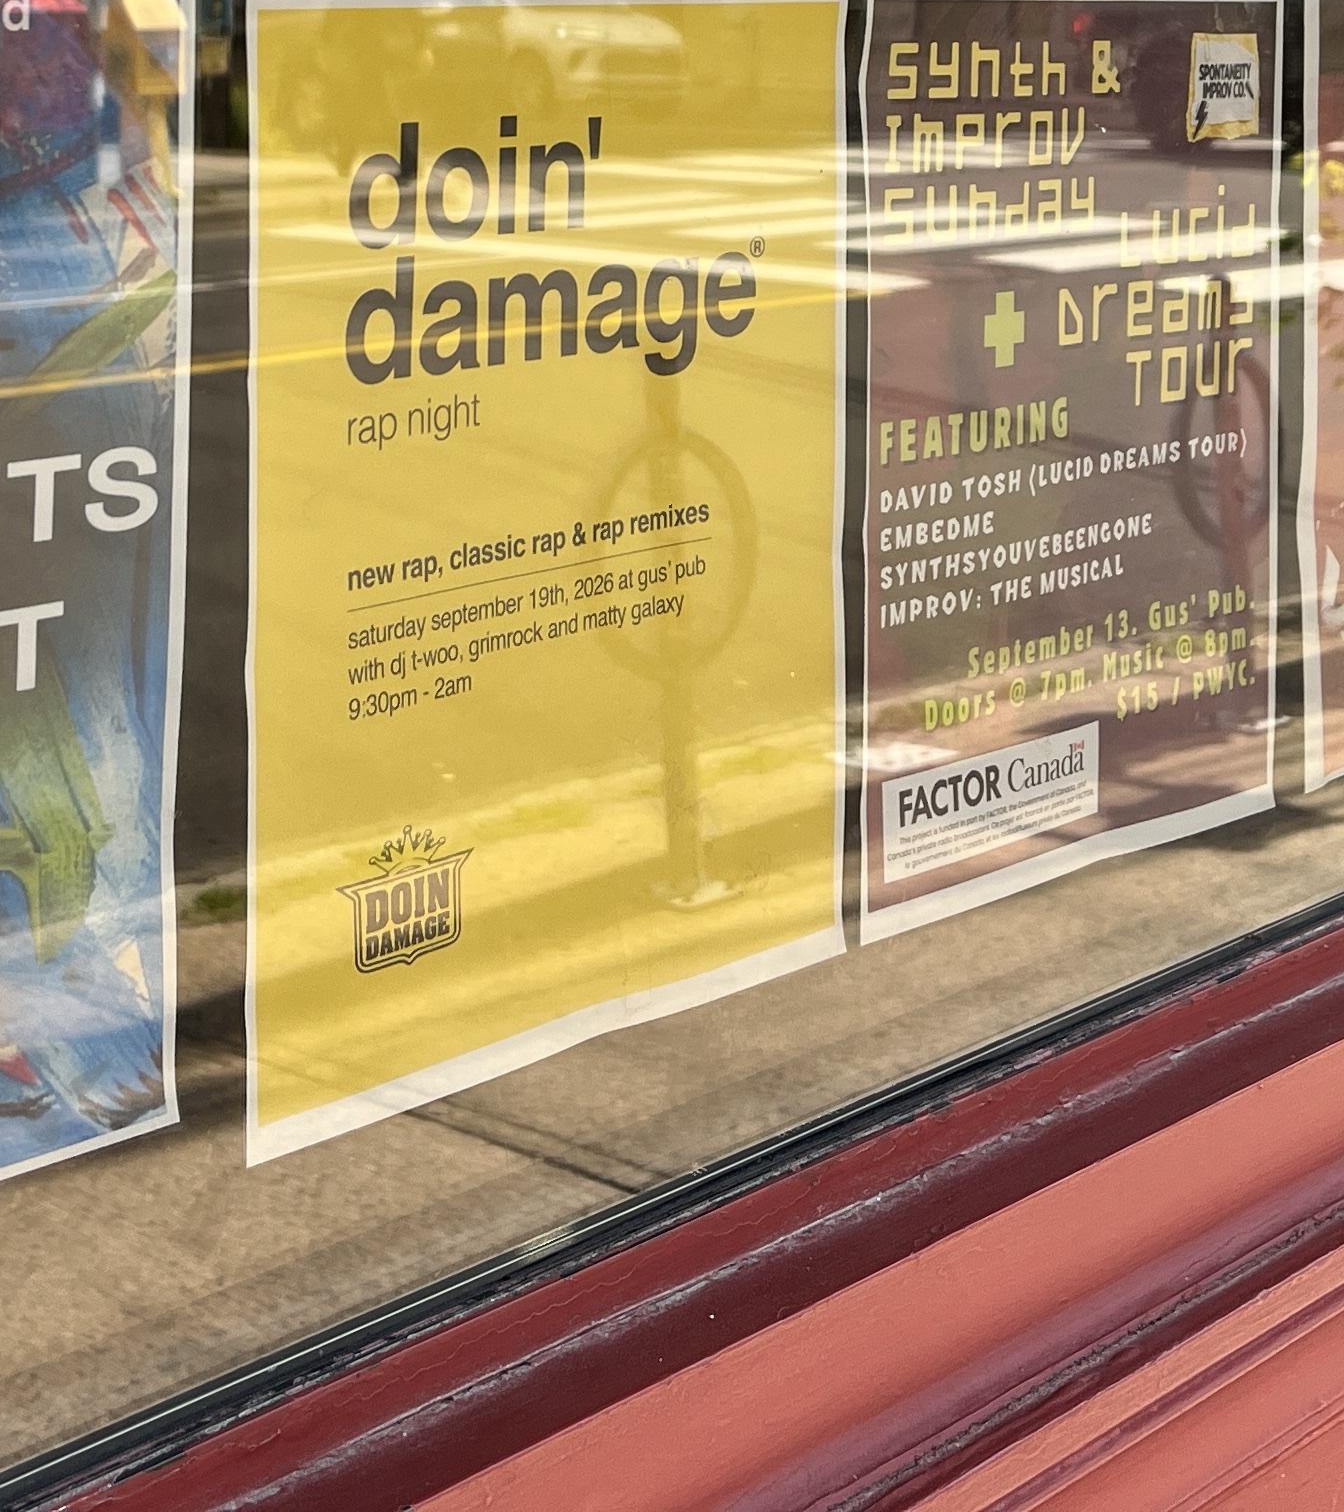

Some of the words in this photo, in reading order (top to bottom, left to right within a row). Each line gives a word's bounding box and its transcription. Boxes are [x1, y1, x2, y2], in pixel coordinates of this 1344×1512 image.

[1092, 40, 1120, 94] &
[1199, 62, 1252, 80] SPONTANEITY
[1202, 81, 1232, 99] IMPROV
[349, 116, 602, 249] doin'
[347, 413, 397, 450] rap
[408, 394, 480, 442] night
[879, 396, 1069, 465] FEATURING
[880, 481, 953, 513] DAVID
[962, 469, 1021, 499] TOSH
[1029, 455, 1092, 496] (LUCID
[1100, 441, 1181, 474] DREAMS
[1188, 428, 1247, 459] TOUR)
[348, 563, 394, 591] new
[402, 554, 443, 582] rap,
[450, 533, 525, 570] classic
[532, 529, 565, 555] rap
[572, 522, 586, 546] &
[593, 519, 624, 544] rap
[631, 503, 709, 535] remixes
[880, 511, 994, 552] EMBEDME
[880, 513, 1153, 590] SYNTHSYOUVEBEENGONE
[348, 615, 426, 649] saturday
[431, 596, 523, 633] september
[529, 584, 569, 610] 19th,
[574, 573, 614, 601] 2026
[618, 567, 633, 590] at
[675, 555, 706, 584] pub
[880, 588, 981, 628] IMPROV:
[991, 576, 1032, 605] THE
[1040, 555, 1124, 595] MUSICAL
[348, 658, 384, 685] with
[391, 650, 406, 678] dj
[411, 642, 463, 670] t-woo,
[468, 621, 543, 663] grimrock
[548, 613, 578, 640] and
[583, 603, 626, 632] matty
[632, 594, 684, 626] galaxy
[967, 623, 1093, 678] September
[349, 691, 417, 721] 9:30pm
[435, 674, 472, 700] 2am
[924, 688, 996, 731] Doors
[1009, 676, 1027, 707] @
[1103, 644, 1164, 682] Music
[1176, 633, 1193, 664] @
[1117, 682, 1158, 721] $15
[899, 764, 1001, 827] FACTOR
[1007, 739, 1086, 792] Canada
[365, 868, 450, 934] DOIN
[365, 911, 450, 961] DAMAGE
